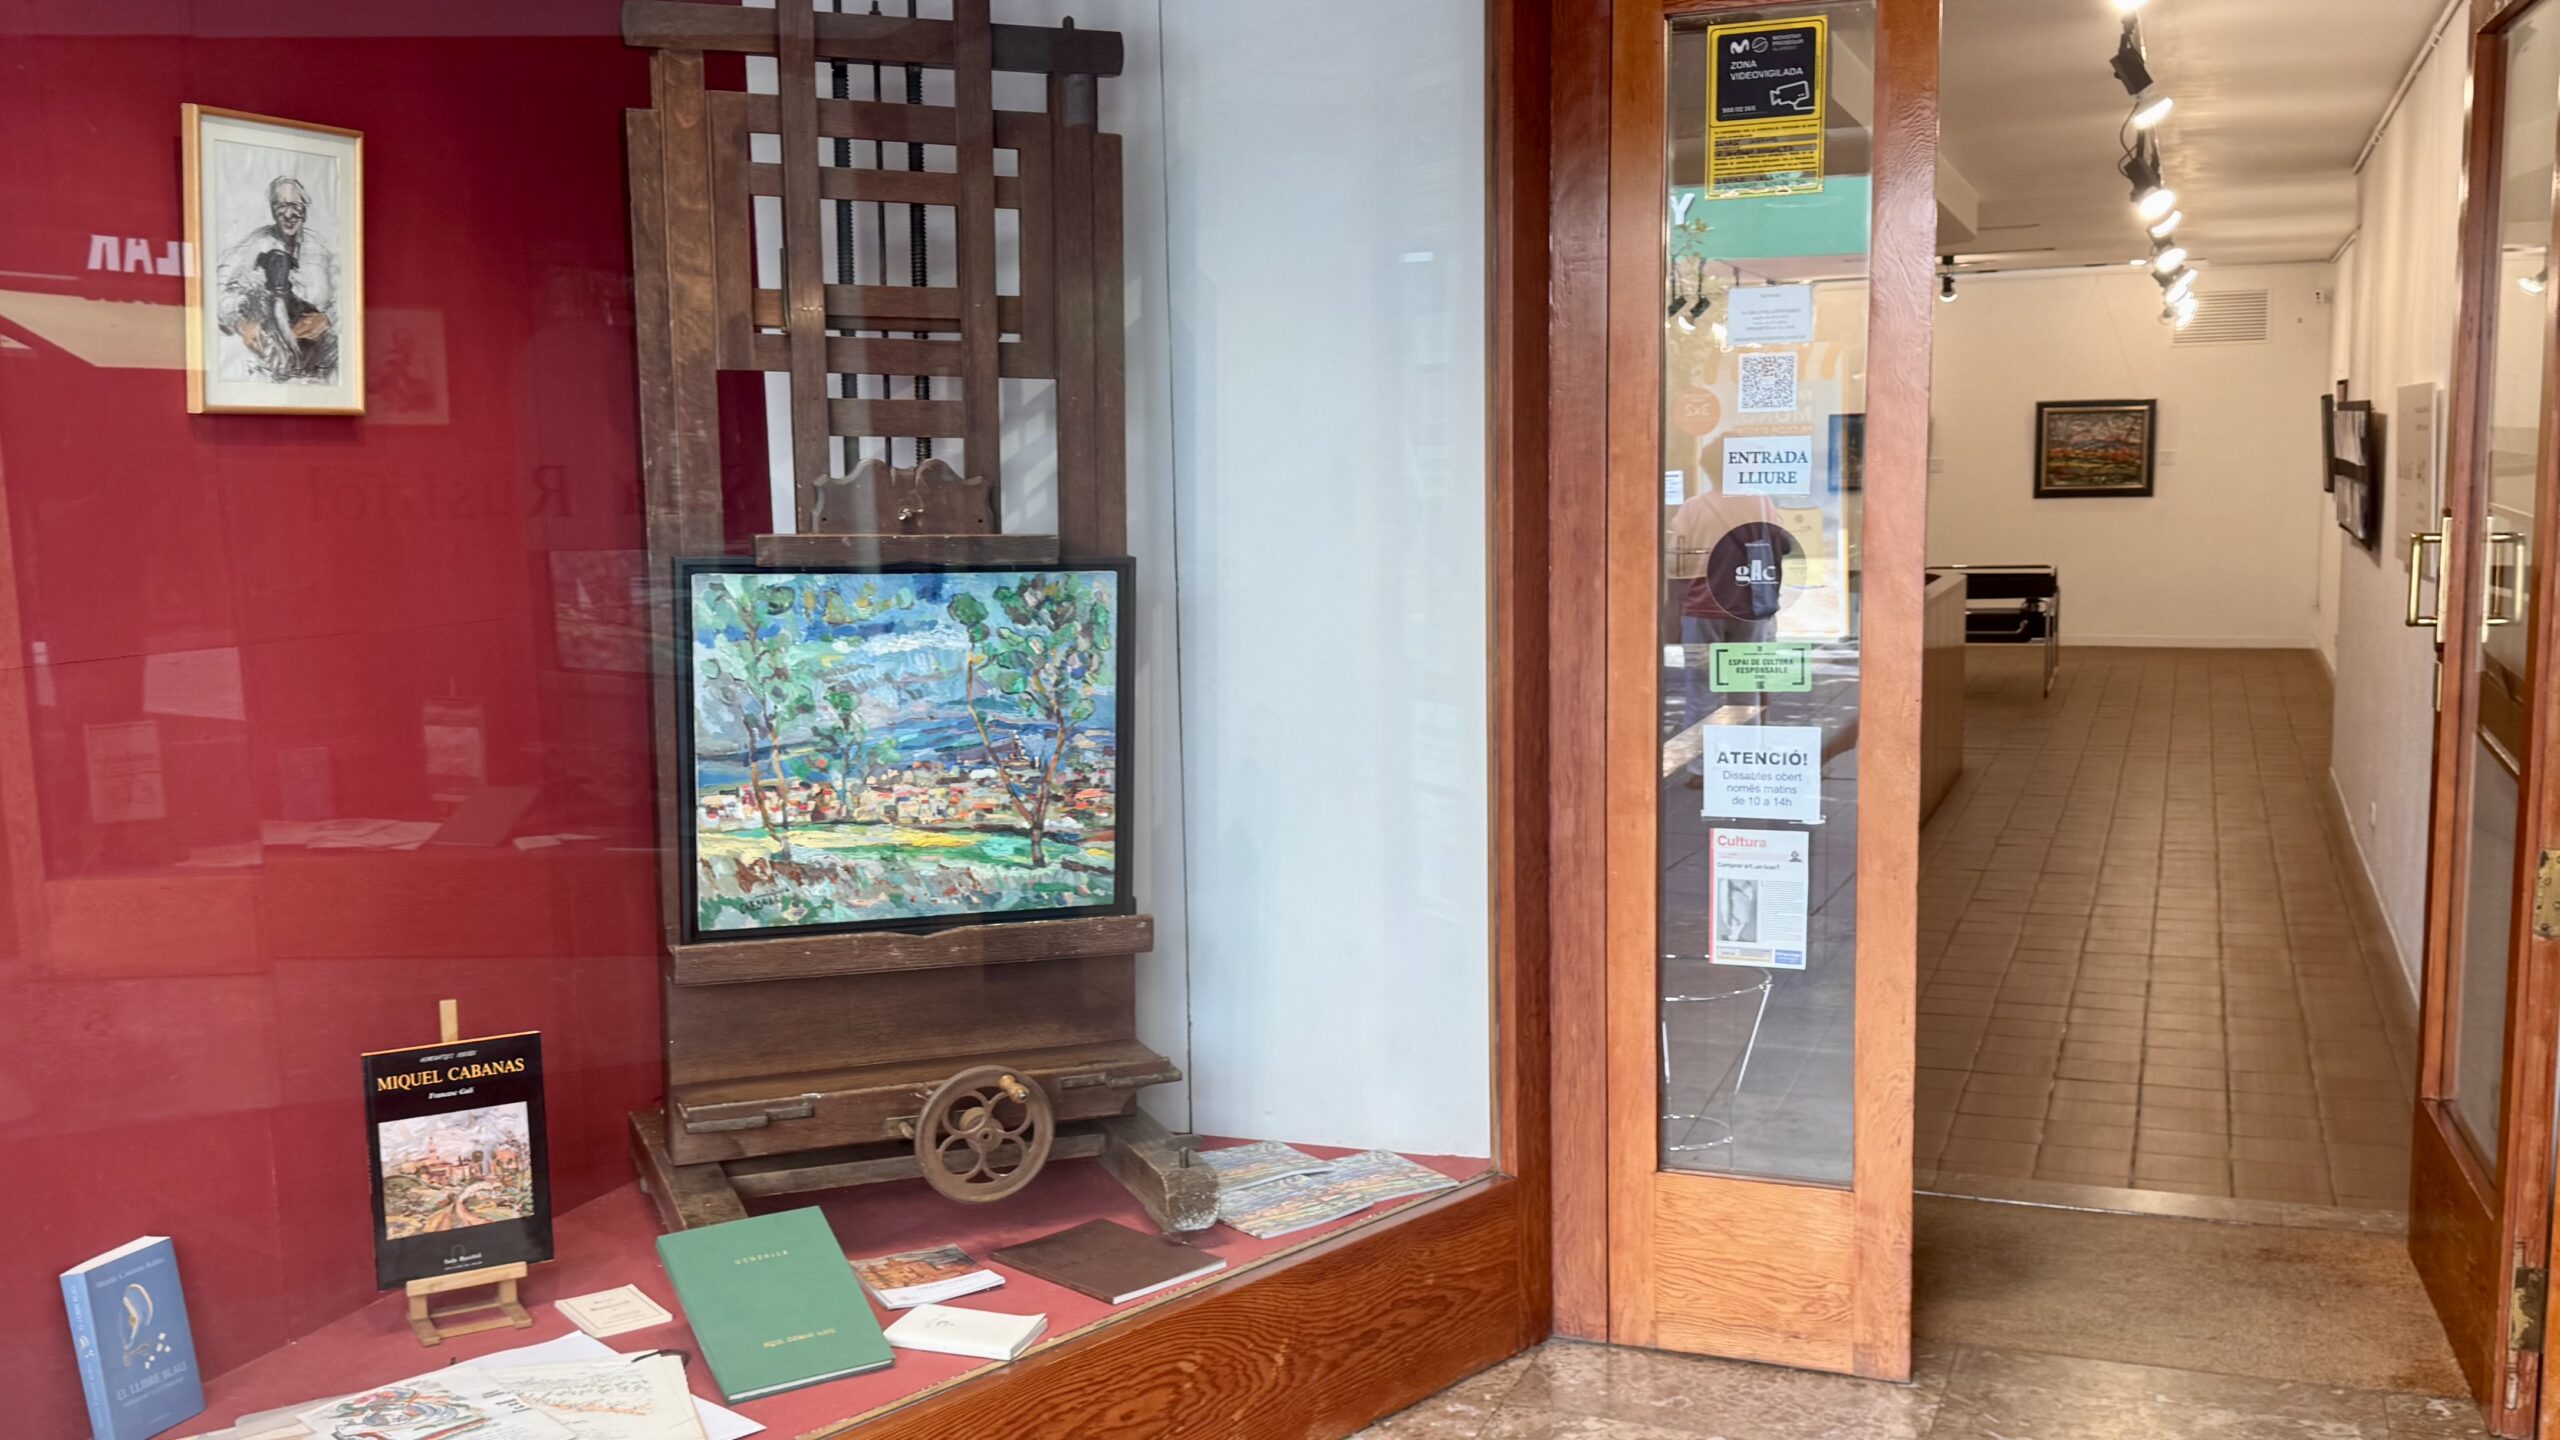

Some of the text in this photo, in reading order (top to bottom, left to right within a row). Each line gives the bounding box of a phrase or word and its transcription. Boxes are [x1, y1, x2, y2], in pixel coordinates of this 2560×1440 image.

[1729, 60, 1758, 70] ZONA
[1729, 67, 1804, 81] VIDEOVIGILADA
[1728, 451, 1808, 465] ENTRADA
[1738, 471, 1798, 484] LLIURE
[1728, 658, 1794, 666] ESPAI DE CULTURA
[1735, 666, 1788, 674] RESPONSABLE
[1716, 750, 1809, 766] ATENCIÓ!
[1722, 770, 1803, 782] Dissabtes obert
[1726, 785, 1798, 795] només matins
[1731, 796, 1793, 807] de 10 a 14h
[1717, 835, 1768, 848] Cultura
[376, 1057, 526, 1093] MIQUEL CABANAS
